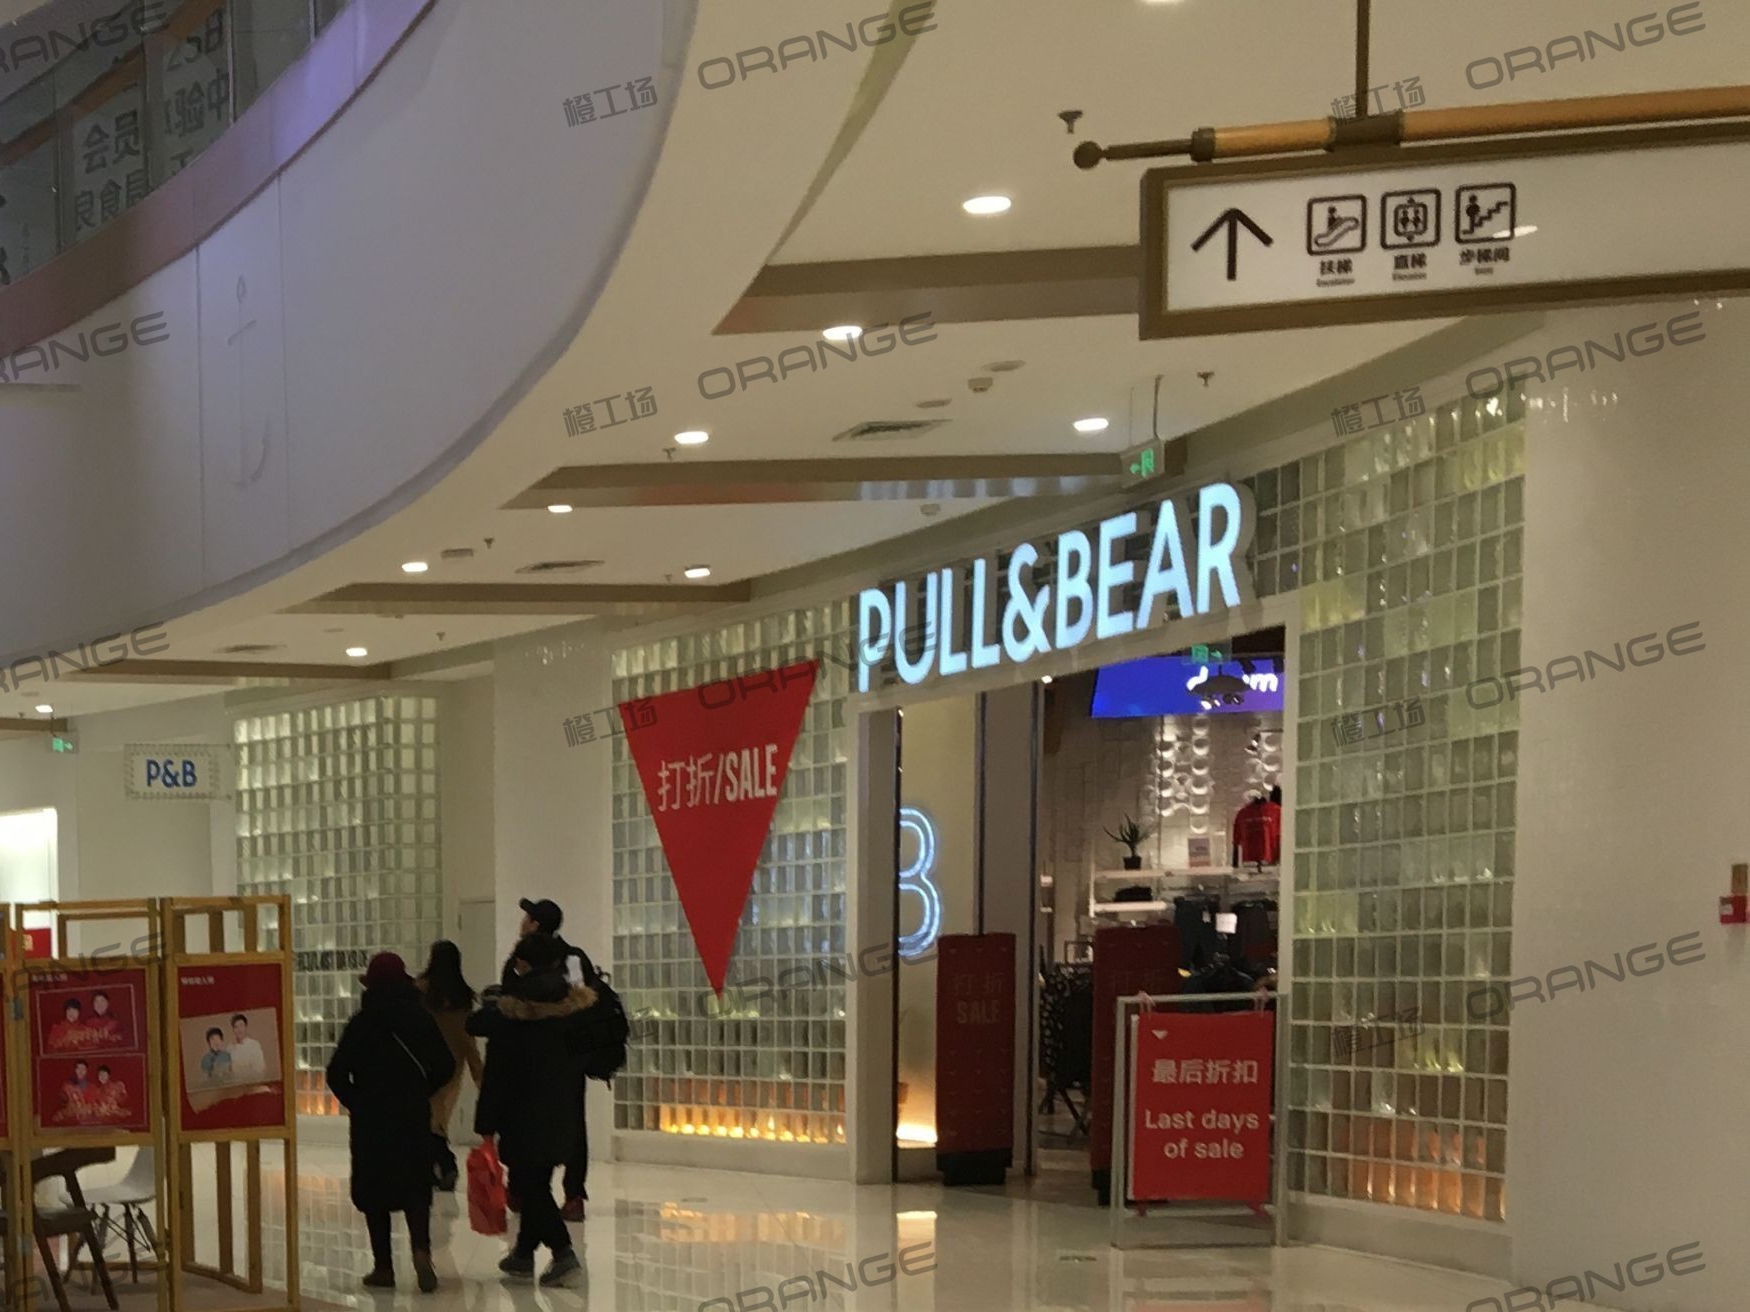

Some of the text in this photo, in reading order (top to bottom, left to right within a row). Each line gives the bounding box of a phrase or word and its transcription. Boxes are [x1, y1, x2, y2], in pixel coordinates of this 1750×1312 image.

[858, 483, 1241, 692] PULL&BEAR
[146, 758, 197, 788] P&B
[1153, 1059, 1258, 1085] 最后折扣
[1145, 1109, 1259, 1133] Last days
[1164, 1138, 1244, 1159] of sale
